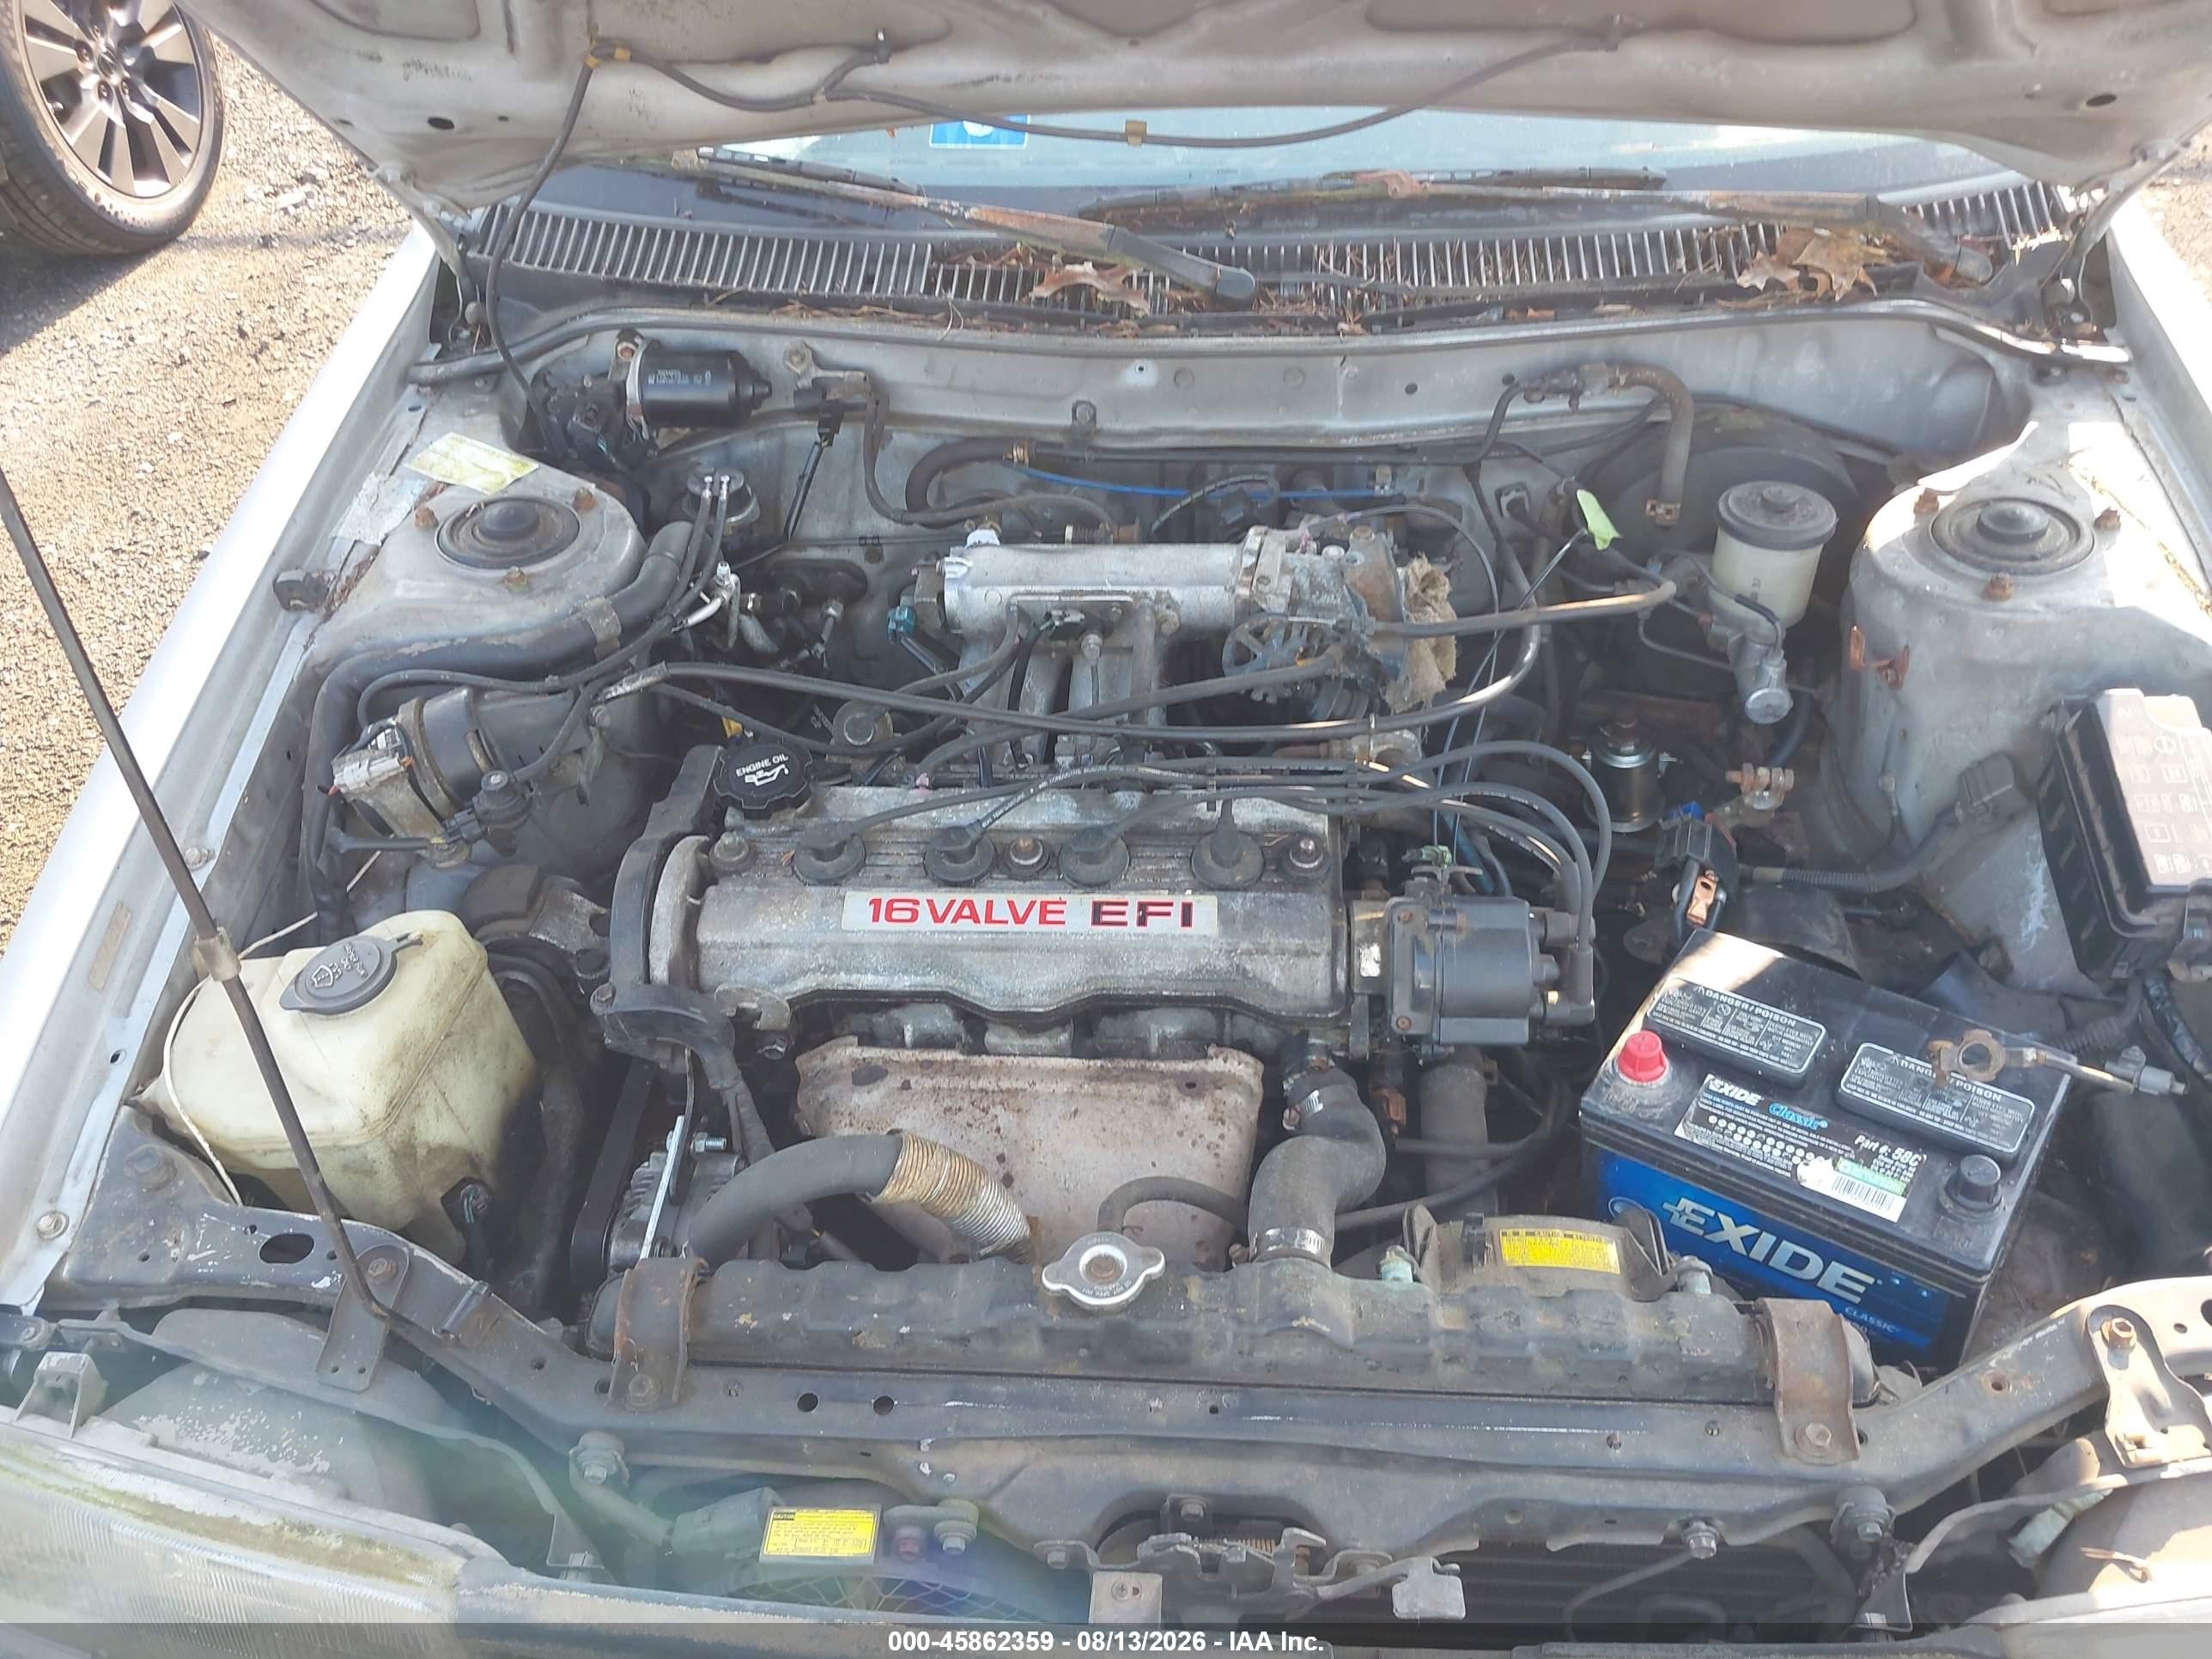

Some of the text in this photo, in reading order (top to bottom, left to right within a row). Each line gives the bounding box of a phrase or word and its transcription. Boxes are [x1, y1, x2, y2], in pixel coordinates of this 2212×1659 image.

[736, 753, 789, 776] ENGINE OIL
[1091, 900, 1194, 928] EFI
[1704, 990, 1797, 1027] DANGER/POISON
[1709, 1078, 1761, 1107] EXIDE
[1899, 1059, 2003, 1103] DANG/POISON
[1855, 1134, 1880, 1152] Part
[1662, 1197, 1875, 1304] EXIDE
[1844, 1306, 1895, 1333] CLASSIC
